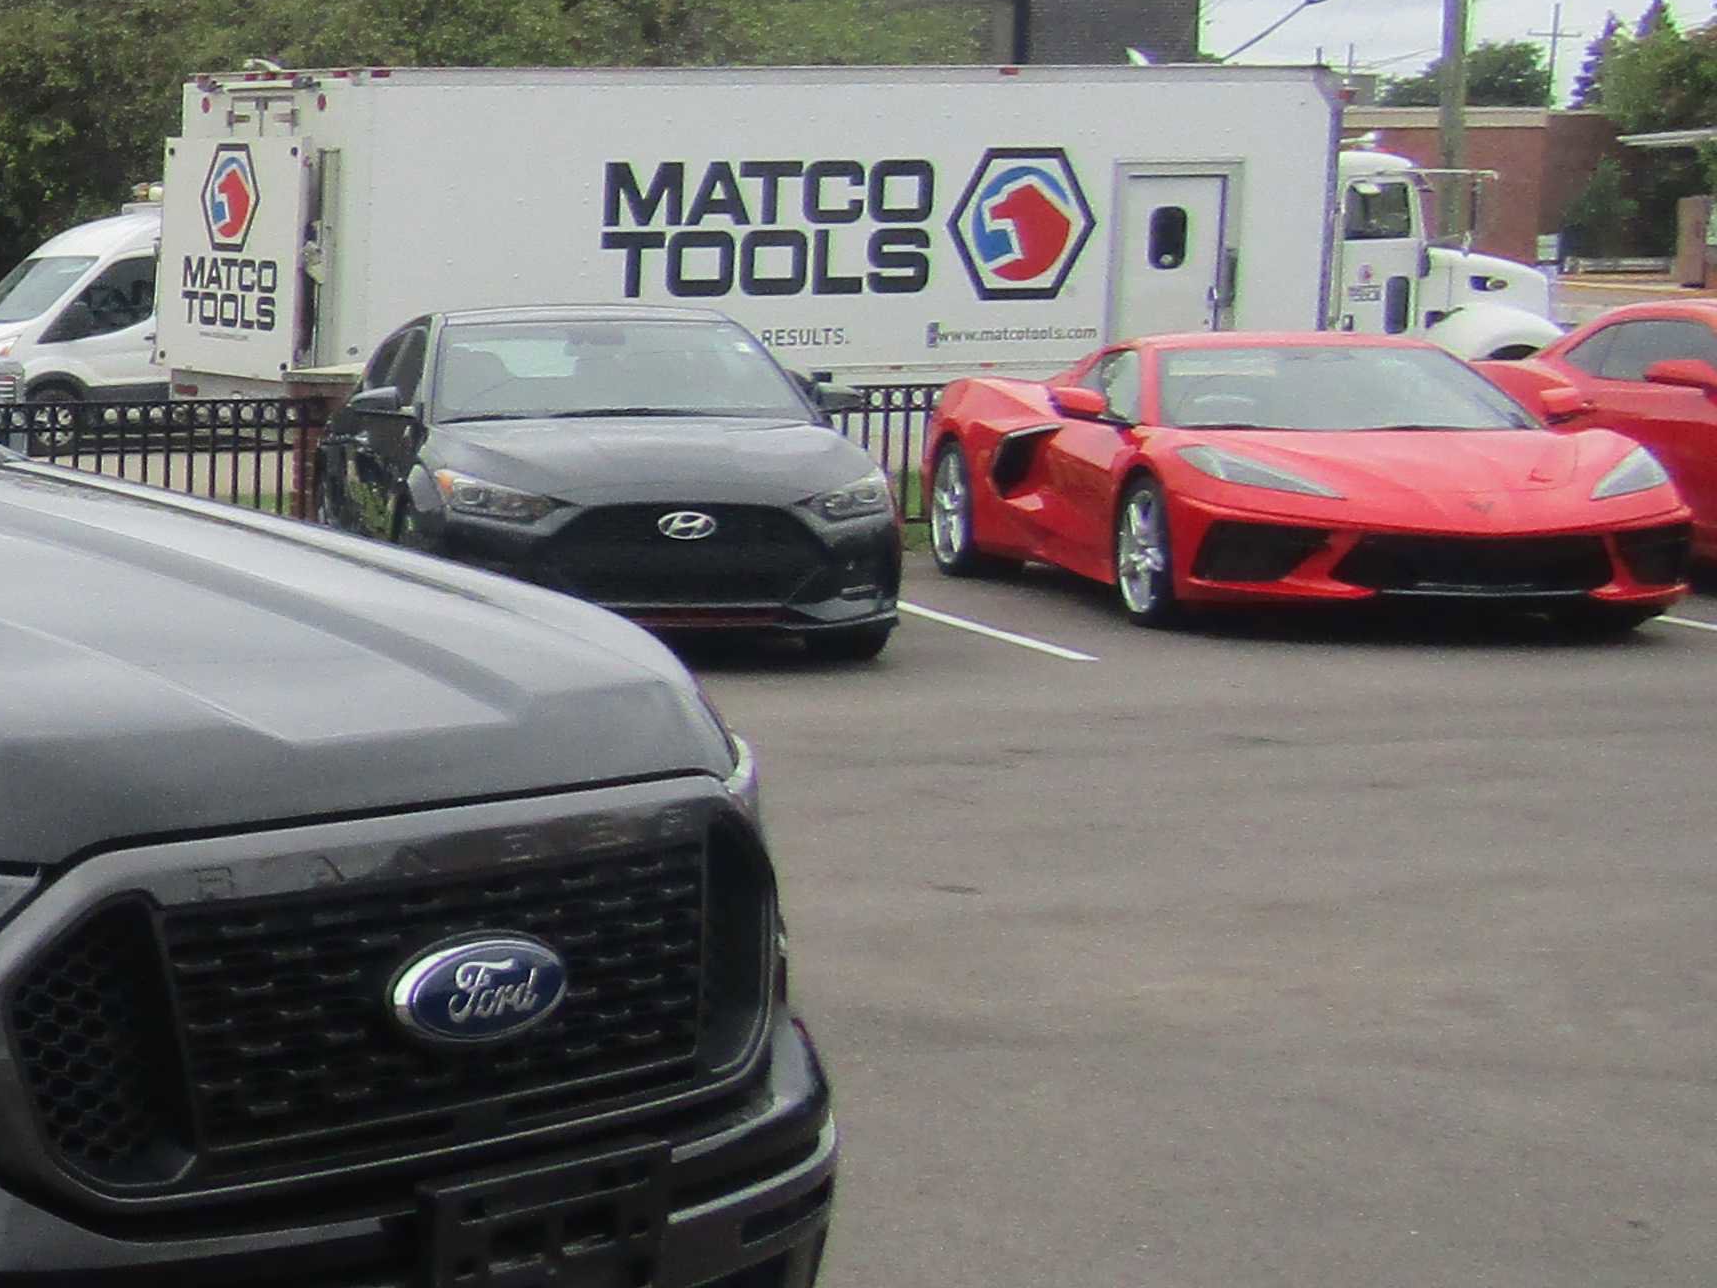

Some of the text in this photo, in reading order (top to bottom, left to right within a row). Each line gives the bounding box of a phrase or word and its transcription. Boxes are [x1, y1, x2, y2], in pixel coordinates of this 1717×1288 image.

[603, 160, 934, 226] MATCO
[182, 255, 277, 293] MATCO
[601, 228, 930, 298] TOOLS
[181, 290, 276, 331] TOOLS
[938, 326, 1097, 342] www.matcotools.com
[448, 958, 539, 1023] Ford
